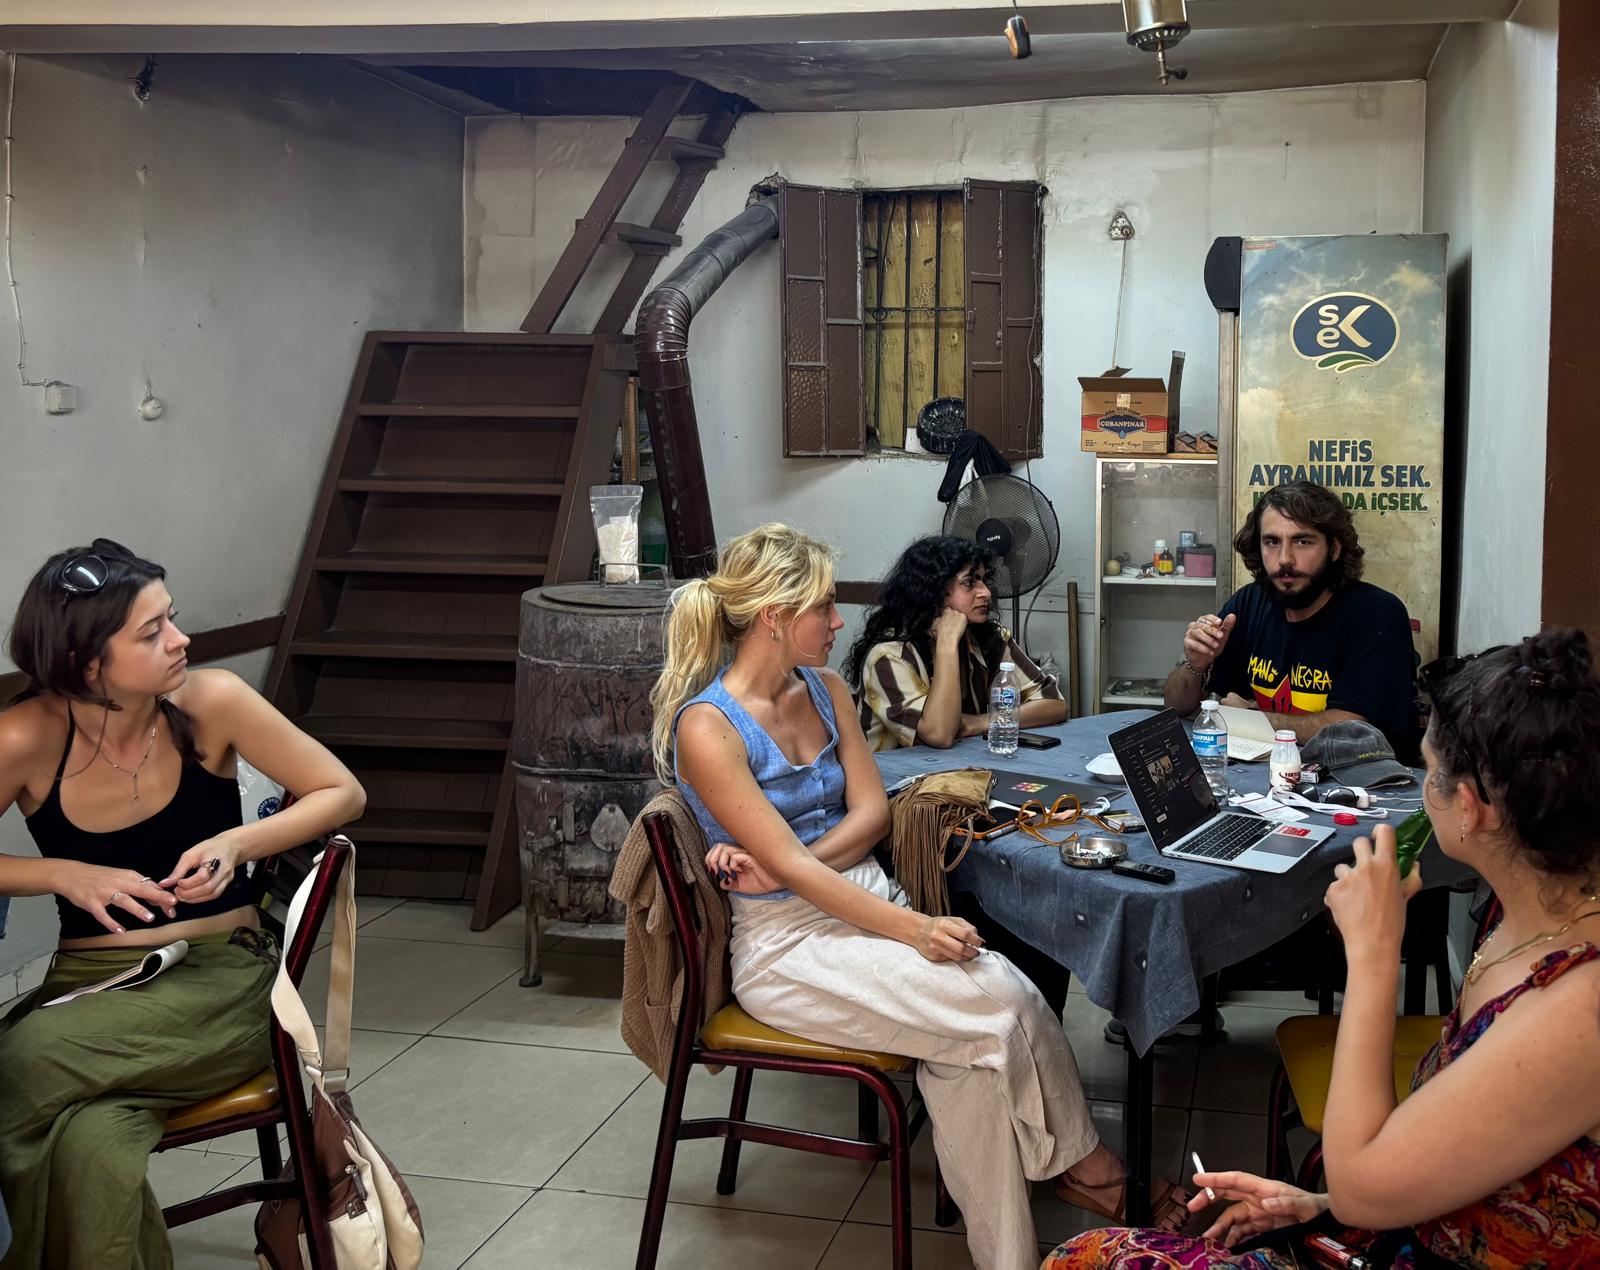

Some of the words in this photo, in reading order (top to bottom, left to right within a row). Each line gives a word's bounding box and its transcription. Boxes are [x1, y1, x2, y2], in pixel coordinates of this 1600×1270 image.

[1248, 465, 1375, 487] AYRANIMIZ
[1380, 465, 1431, 487] SEK.
[1291, 661, 1332, 691] NEGRA
